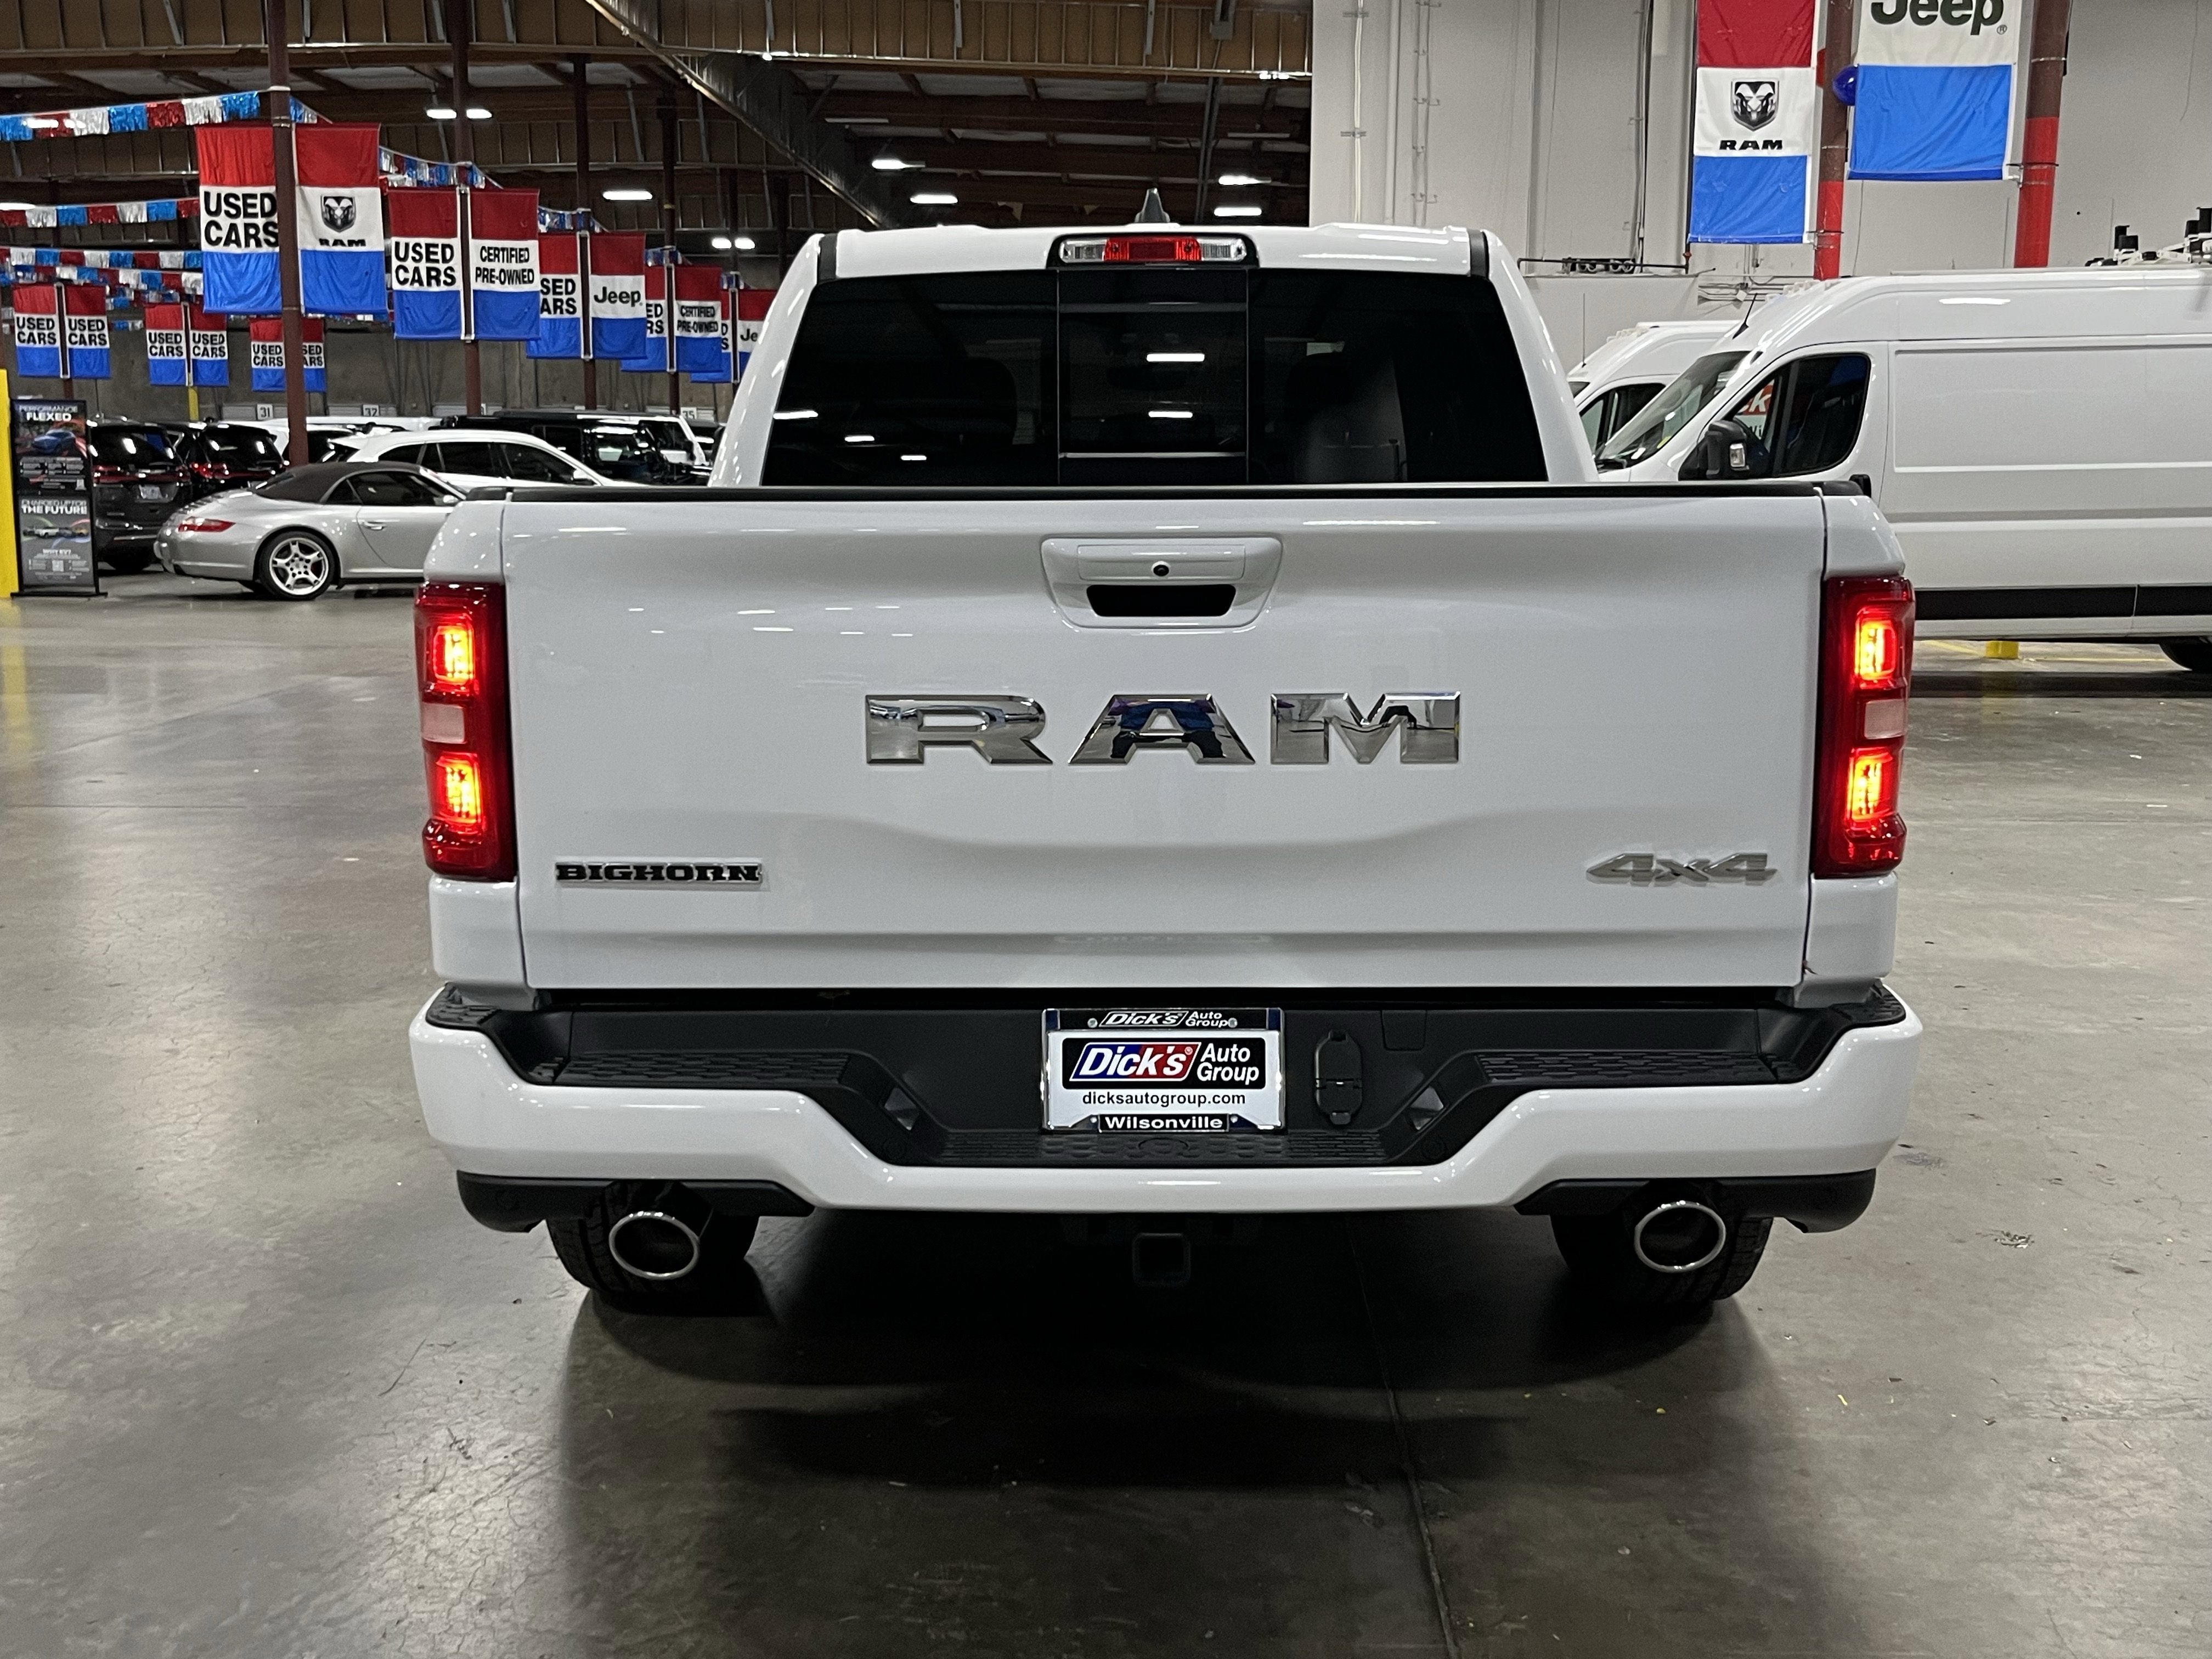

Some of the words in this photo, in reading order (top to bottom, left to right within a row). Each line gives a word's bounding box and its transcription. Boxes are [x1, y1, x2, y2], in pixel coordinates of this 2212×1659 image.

[1871, 0, 2005, 35] Jeep
[1719, 140, 1782, 150] RAM
[204, 191, 277, 219] USED
[204, 220, 279, 247] CARS
[319, 238, 366, 247] RAM
[394, 241, 454, 263] USED
[479, 246, 530, 263] CERTIFIED
[395, 264, 456, 287] CARS
[475, 267, 534, 285] PRE-OWNED
[540, 278, 576, 295] SED
[593, 286, 641, 307] Jeep
[540, 297, 577, 315] ARS
[646, 303, 663, 318] ED
[680, 306, 716, 318] CERTIFIED
[16, 317, 55, 330] USED
[68, 318, 105, 331] USED
[647, 319, 664, 334] RS
[676, 319, 719, 333] PRE-OWNED
[17, 331, 57, 345] CARS
[68, 333, 108, 346] CARS
[148, 332, 182, 344] USED
[193, 332, 225, 345] USED
[740, 329, 758, 342] Je
[149, 345, 184, 357] CARS
[193, 346, 226, 358] CARS
[252, 343, 282, 355] USED
[303, 345, 322, 355] SED
[253, 356, 284, 366] CARS
[303, 356, 323, 366] ARS
[26, 412, 72, 421] FLEXED
[259, 407, 270, 418] 31
[21, 505, 43, 514] THE
[45, 505, 87, 515] FUTURE
[866, 692, 1462, 765] RAM
[555, 862, 763, 883] BIGHORN
[1586, 853, 1778, 883] 4x4
[1105, 1012, 1179, 1025] Dick's
[1189, 1011, 1223, 1020] Auto
[1186, 1018, 1229, 1028] Group
[1200, 1043, 1251, 1063] Auto
[1079, 1046, 1187, 1076] Dick's
[1197, 1062, 1260, 1085] Group
[1082, 1092, 1246, 1107] dicksautogroup.com
[1105, 1116, 1223, 1129] Wilsonville
